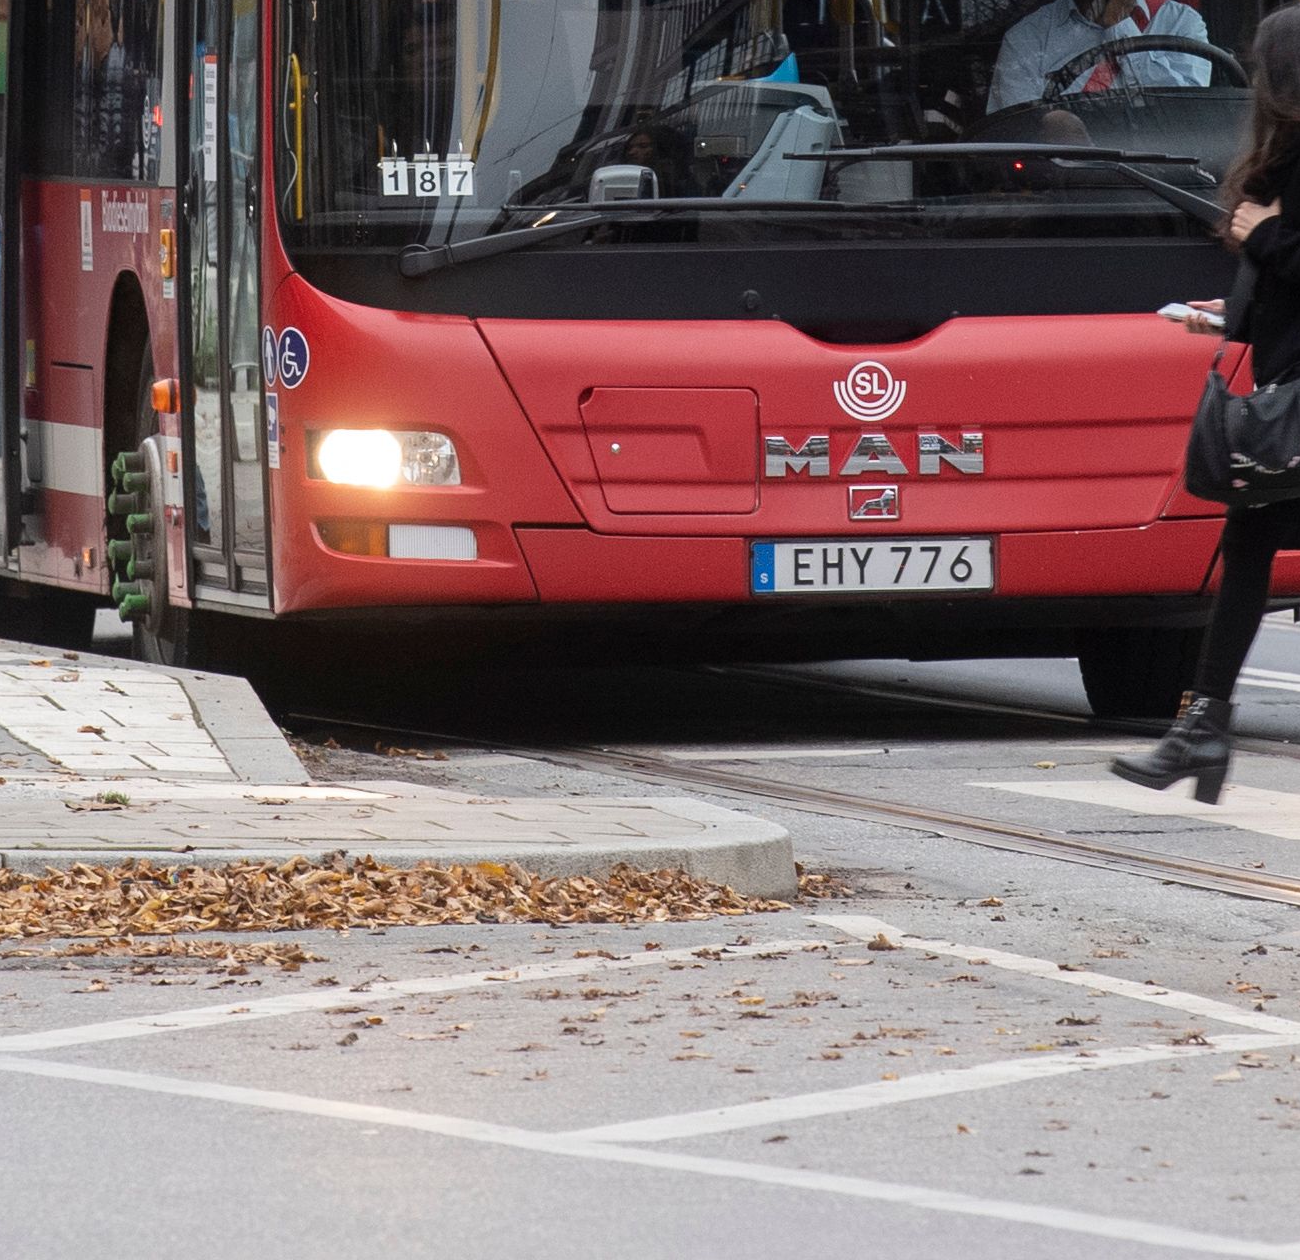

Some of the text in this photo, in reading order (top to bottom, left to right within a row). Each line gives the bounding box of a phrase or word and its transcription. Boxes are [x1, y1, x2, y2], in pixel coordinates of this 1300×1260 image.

[855, 372, 887, 396] SL
[764, 432, 985, 478] MAN
[759, 545, 973, 586] S EHY 776
